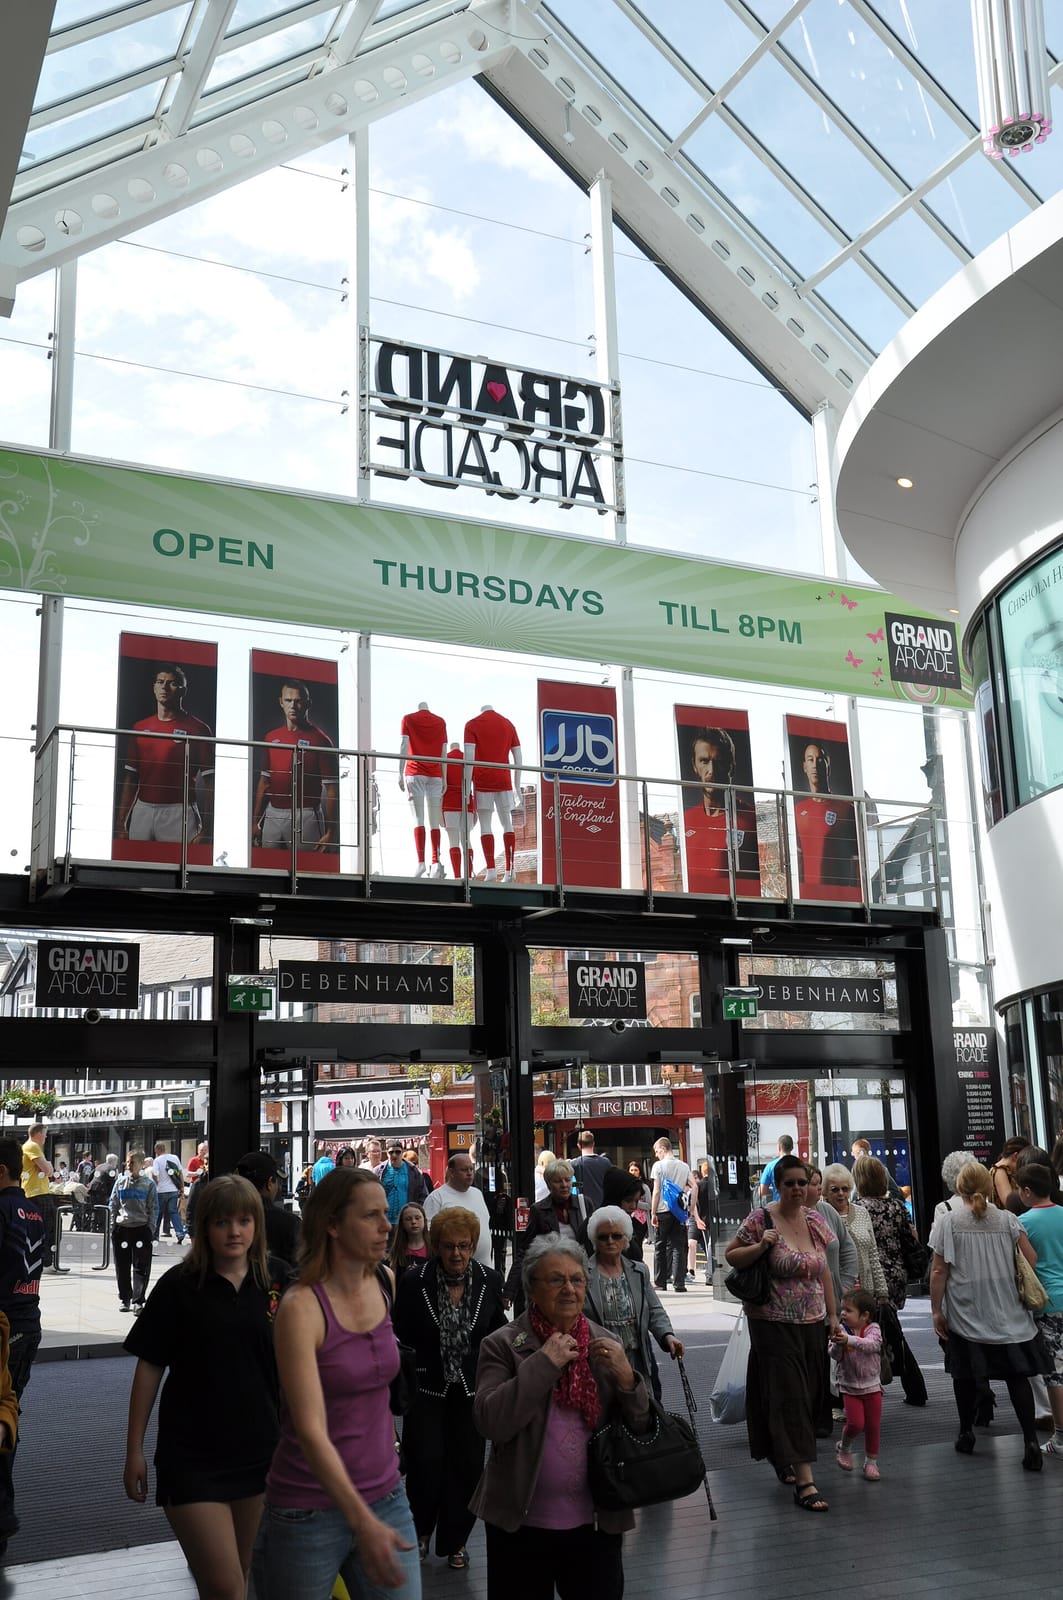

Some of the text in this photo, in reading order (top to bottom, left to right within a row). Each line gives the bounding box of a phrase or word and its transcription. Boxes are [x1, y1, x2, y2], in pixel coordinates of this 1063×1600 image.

[1052, 565, 1063, 584] H
[152, 528, 803, 645] OPEN THURSDAYS TILL 8PM
[891, 621, 953, 652] GRAND
[894, 645, 955, 675] ARCADE
[559, 793, 606, 809] Tailored
[563, 807, 614, 827] England
[48, 947, 129, 973] GRAND
[47, 971, 128, 996] ARCADE
[280, 972, 449, 993] DEBENHAMS
[576, 966, 637, 988] GRAND
[577, 987, 638, 1008] ARCADE
[953, 1032, 987, 1048] RAND
[956, 1047, 989, 1063] RCADE
[597, 1101, 648, 1115] ARCADE
